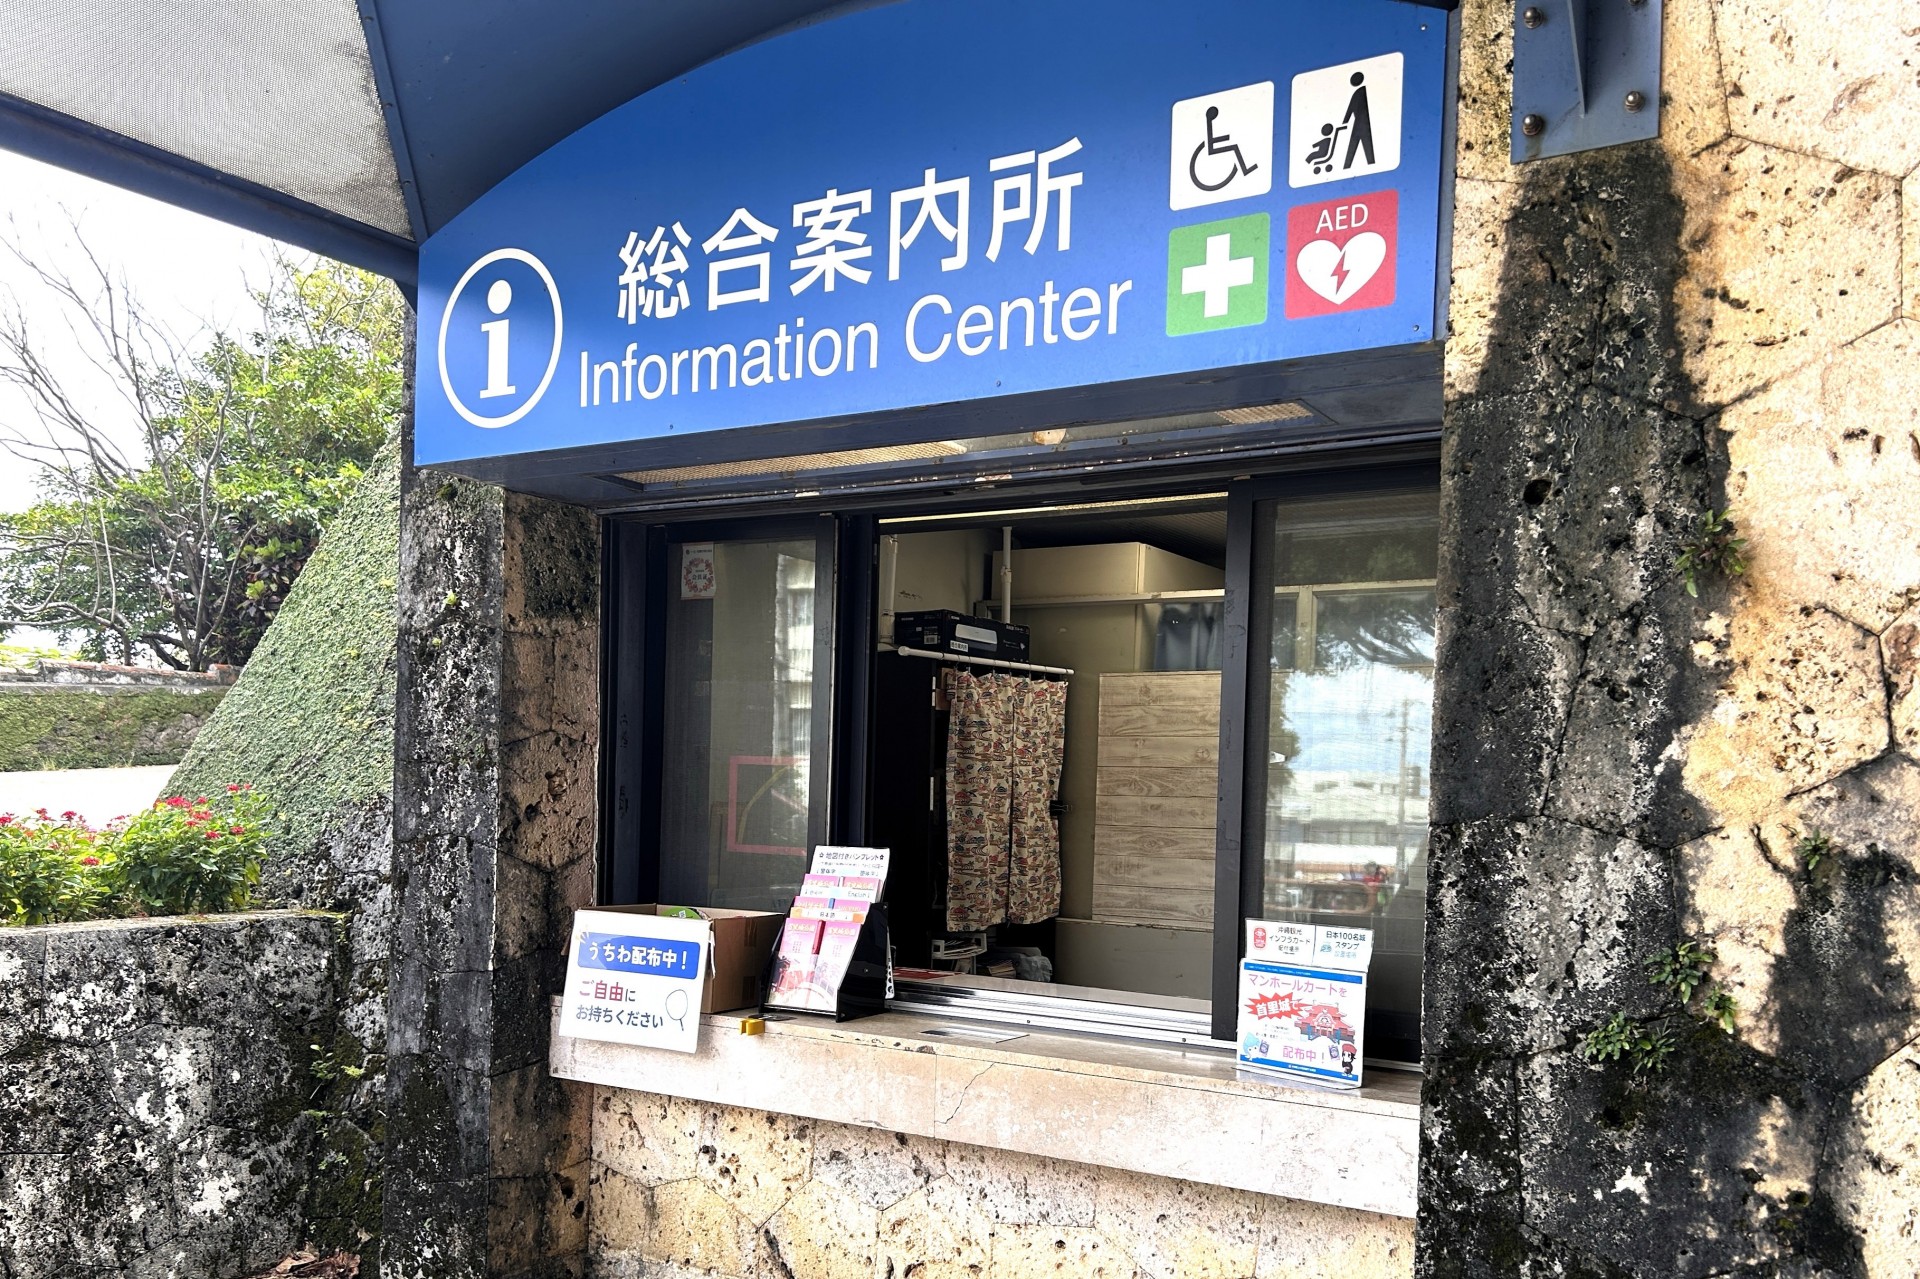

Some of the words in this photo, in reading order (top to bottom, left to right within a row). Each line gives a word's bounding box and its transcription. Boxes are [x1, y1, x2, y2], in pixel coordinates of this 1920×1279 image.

[617, 137, 1084, 325] 総合案内所
[1315, 203, 1369, 234] AED
[579, 317, 879, 408] Information
[904, 279, 1133, 364] Center
[1335, 941, 1360, 951] スタンプ
[579, 980, 637, 1003] ご自由に
[576, 1004, 664, 1029] お持ちください
